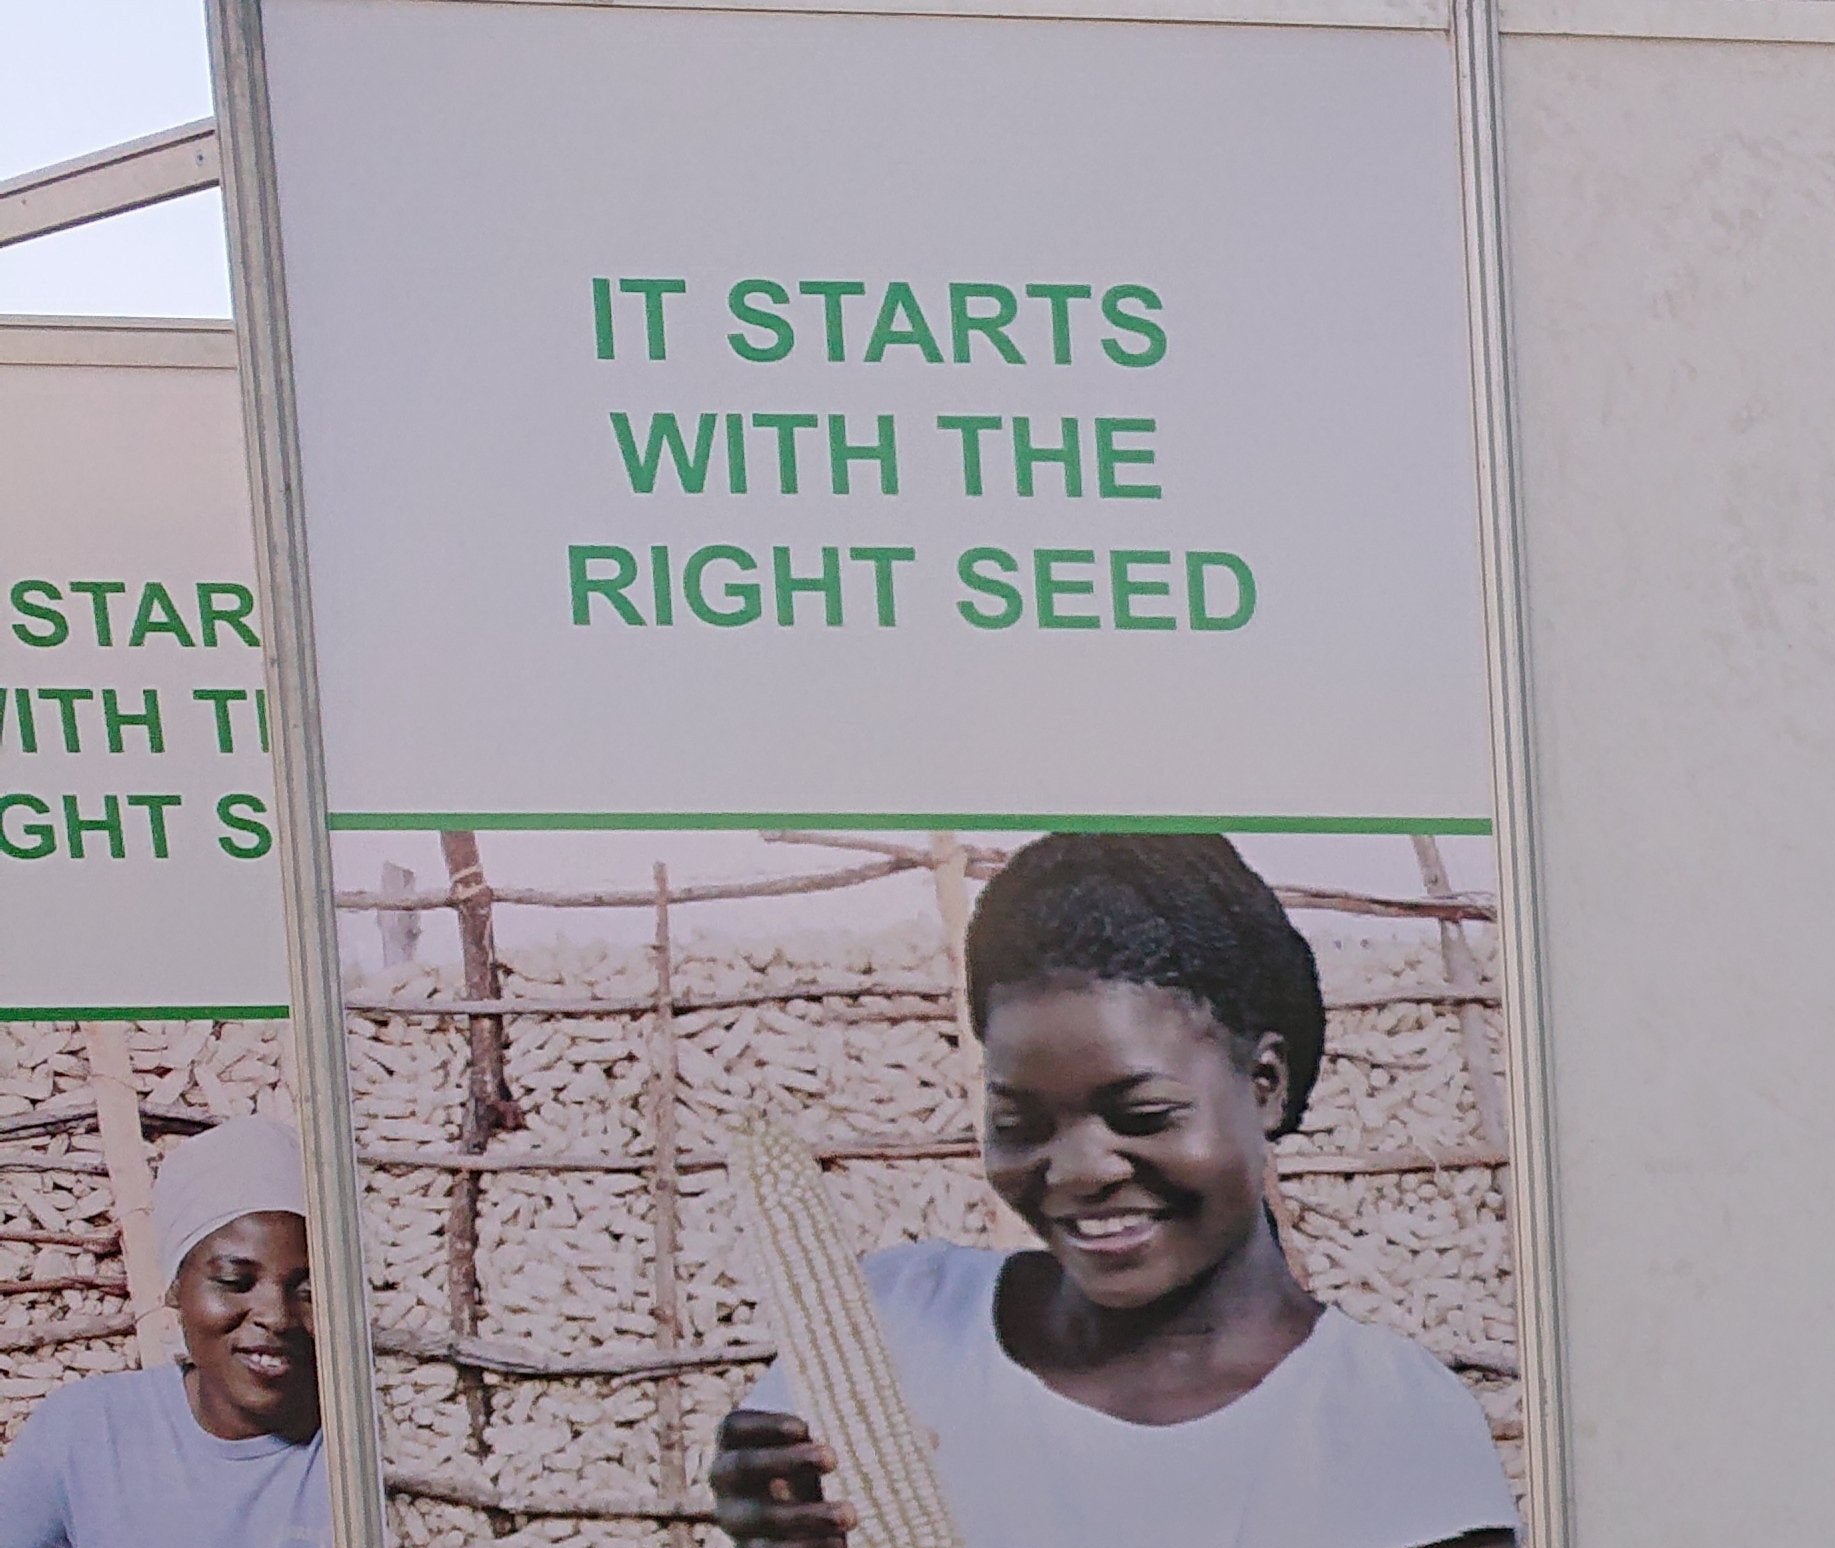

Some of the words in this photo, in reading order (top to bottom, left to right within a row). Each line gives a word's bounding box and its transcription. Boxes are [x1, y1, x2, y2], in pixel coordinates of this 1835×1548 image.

[592, 278, 686, 360] IT
[729, 279, 1167, 367] STARTS
[611, 412, 899, 495] WITH
[938, 416, 1161, 499] THE
[11, 581, 259, 646] STAR
[568, 545, 915, 627] RIGHT
[958, 547, 1257, 631] SEED
[0, 688, 165, 753] ITH
[0, 794, 180, 859] GHT
